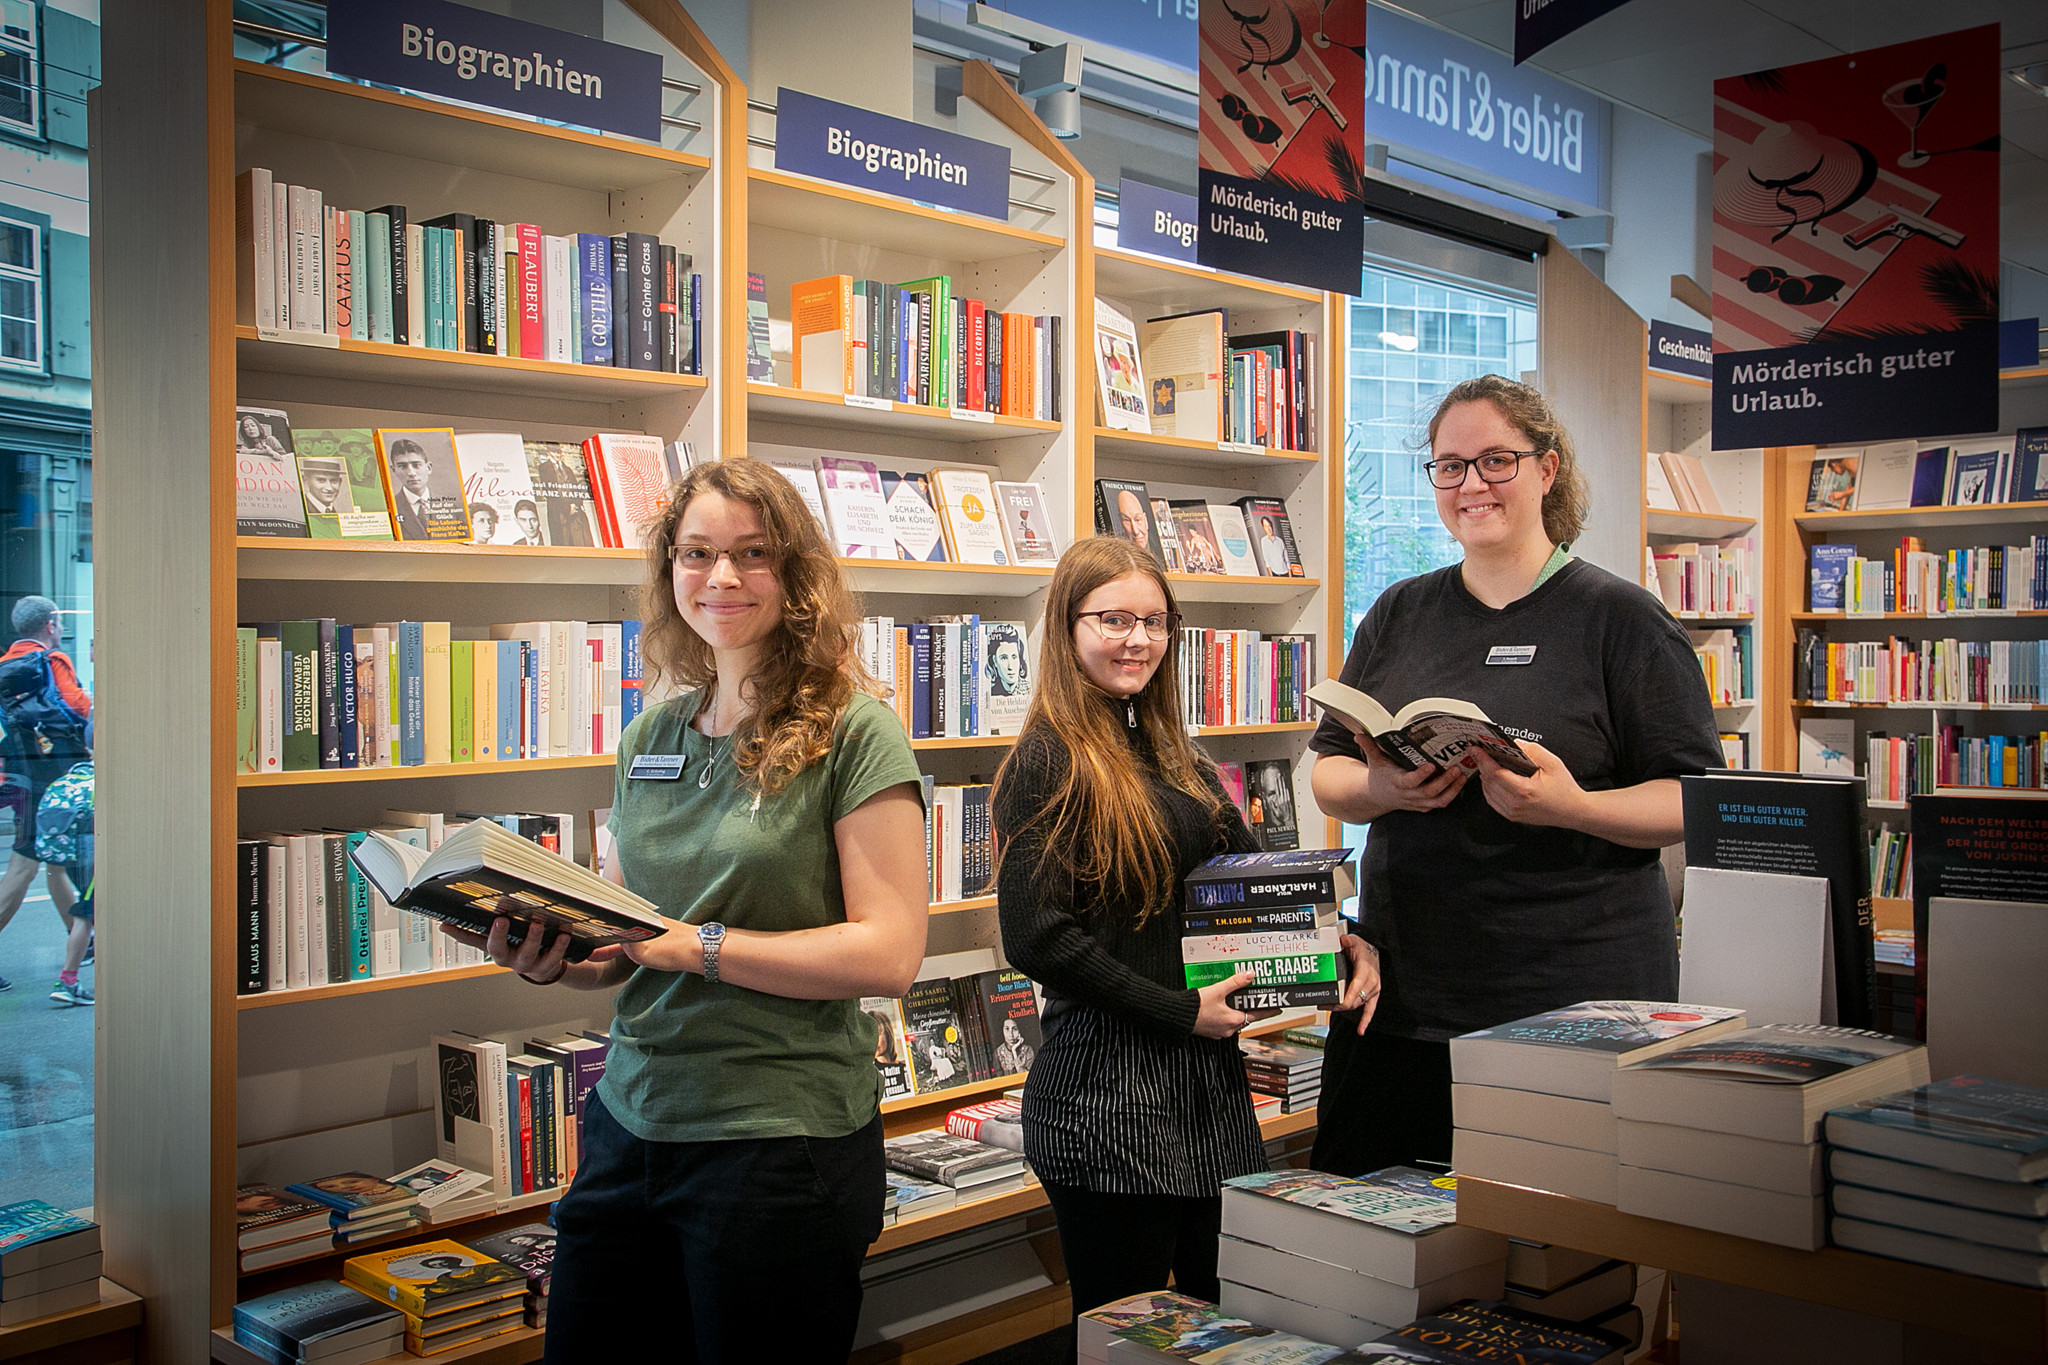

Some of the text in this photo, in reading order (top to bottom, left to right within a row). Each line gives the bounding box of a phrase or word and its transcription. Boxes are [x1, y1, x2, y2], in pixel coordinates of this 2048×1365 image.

[401, 22, 603, 99] Biographien
[827, 126, 968, 186] Biographien
[1210, 184, 1342, 232] Mörderisch guter
[1210, 212, 1269, 244] Urlaub.
[336, 238, 352, 327] CAMUS
[395, 254, 403, 295] ZYGMUNT
[466, 251, 476, 306] Dostojewskij
[525, 241, 538, 323] FLAUBERT
[641, 242, 652, 317] Günter Grass
[591, 282, 607, 347] GOETHE
[921, 294, 930, 325] LEBEN
[1731, 347, 1956, 385] Mörderisch guter
[1731, 387, 1824, 414] Urlaub.
[464, 472, 535, 504] Milena
[548, 482, 589, 490] Friedländer
[562, 490, 591, 499] KAFKA
[952, 485, 986, 494] TROTZDEM
[1124, 484, 1144, 492] STEWART
[847, 505, 875, 513] KAISERIN
[894, 505, 926, 515] SCHACH
[966, 503, 981, 514] JA
[1009, 496, 1034, 507] FREI
[846, 512, 879, 520] ELISABETH
[910, 514, 935, 525] KÖNIG
[975, 523, 995, 531] LEBEN
[425, 646, 446, 654] Kafka
[294, 654, 302, 731] VERWANDLUNG
[303, 656, 311, 729] GRENZENLOSE
[344, 652, 354, 724] VICTOR HUGO
[541, 670, 549, 714] KAFKA
[1718, 803, 1809, 817] ER IST EIN GUTER VATER.
[1722, 814, 1807, 827] UND EIN GUTER KILLER.
[1940, 816, 2004, 826] NACH DEM
[1947, 838, 2007, 849] DER NEUE
[334, 843, 343, 882] NOVALIS
[1965, 851, 2037, 862] VON JUSTIN
[251, 877, 259, 906] Thomas
[1193, 882, 1245, 906] PARTIKEL
[1250, 882, 1316, 893] HARLANDER
[1270, 912, 1311, 924] PARENTS
[1857, 896, 1869, 926] DER
[251, 910, 259, 940] MANN
[359, 912, 369, 957] Otfried
[1246, 932, 1319, 945] LUCY CLARKE
[1259, 942, 1309, 954] THE HIKE
[251, 944, 259, 974] KLAUS
[1235, 956, 1319, 978] MARC RAABE
[997, 980, 1031, 992] Bone Black
[1000, 973, 1011, 982] bell
[925, 987, 946, 995] SAABYE
[990, 991, 1032, 1003] Erinnerungen
[1304, 990, 1330, 998] HEIMWEG
[908, 996, 950, 1008] CHRISTENSEN
[1234, 992, 1291, 1010] FITZEK
[1008, 1008, 1035, 1019] Kindheit
[1510, 1027, 1625, 1041] GORDON
[948, 1117, 977, 1140] KING
[267, 1288, 333, 1310] CASPAR
[270, 1293, 357, 1322] FRIEDRICH
[281, 1293, 332, 1312] DAVID
[1437, 1312, 1591, 1353] DIE KUNST
[1466, 1330, 1524, 1348] DES
